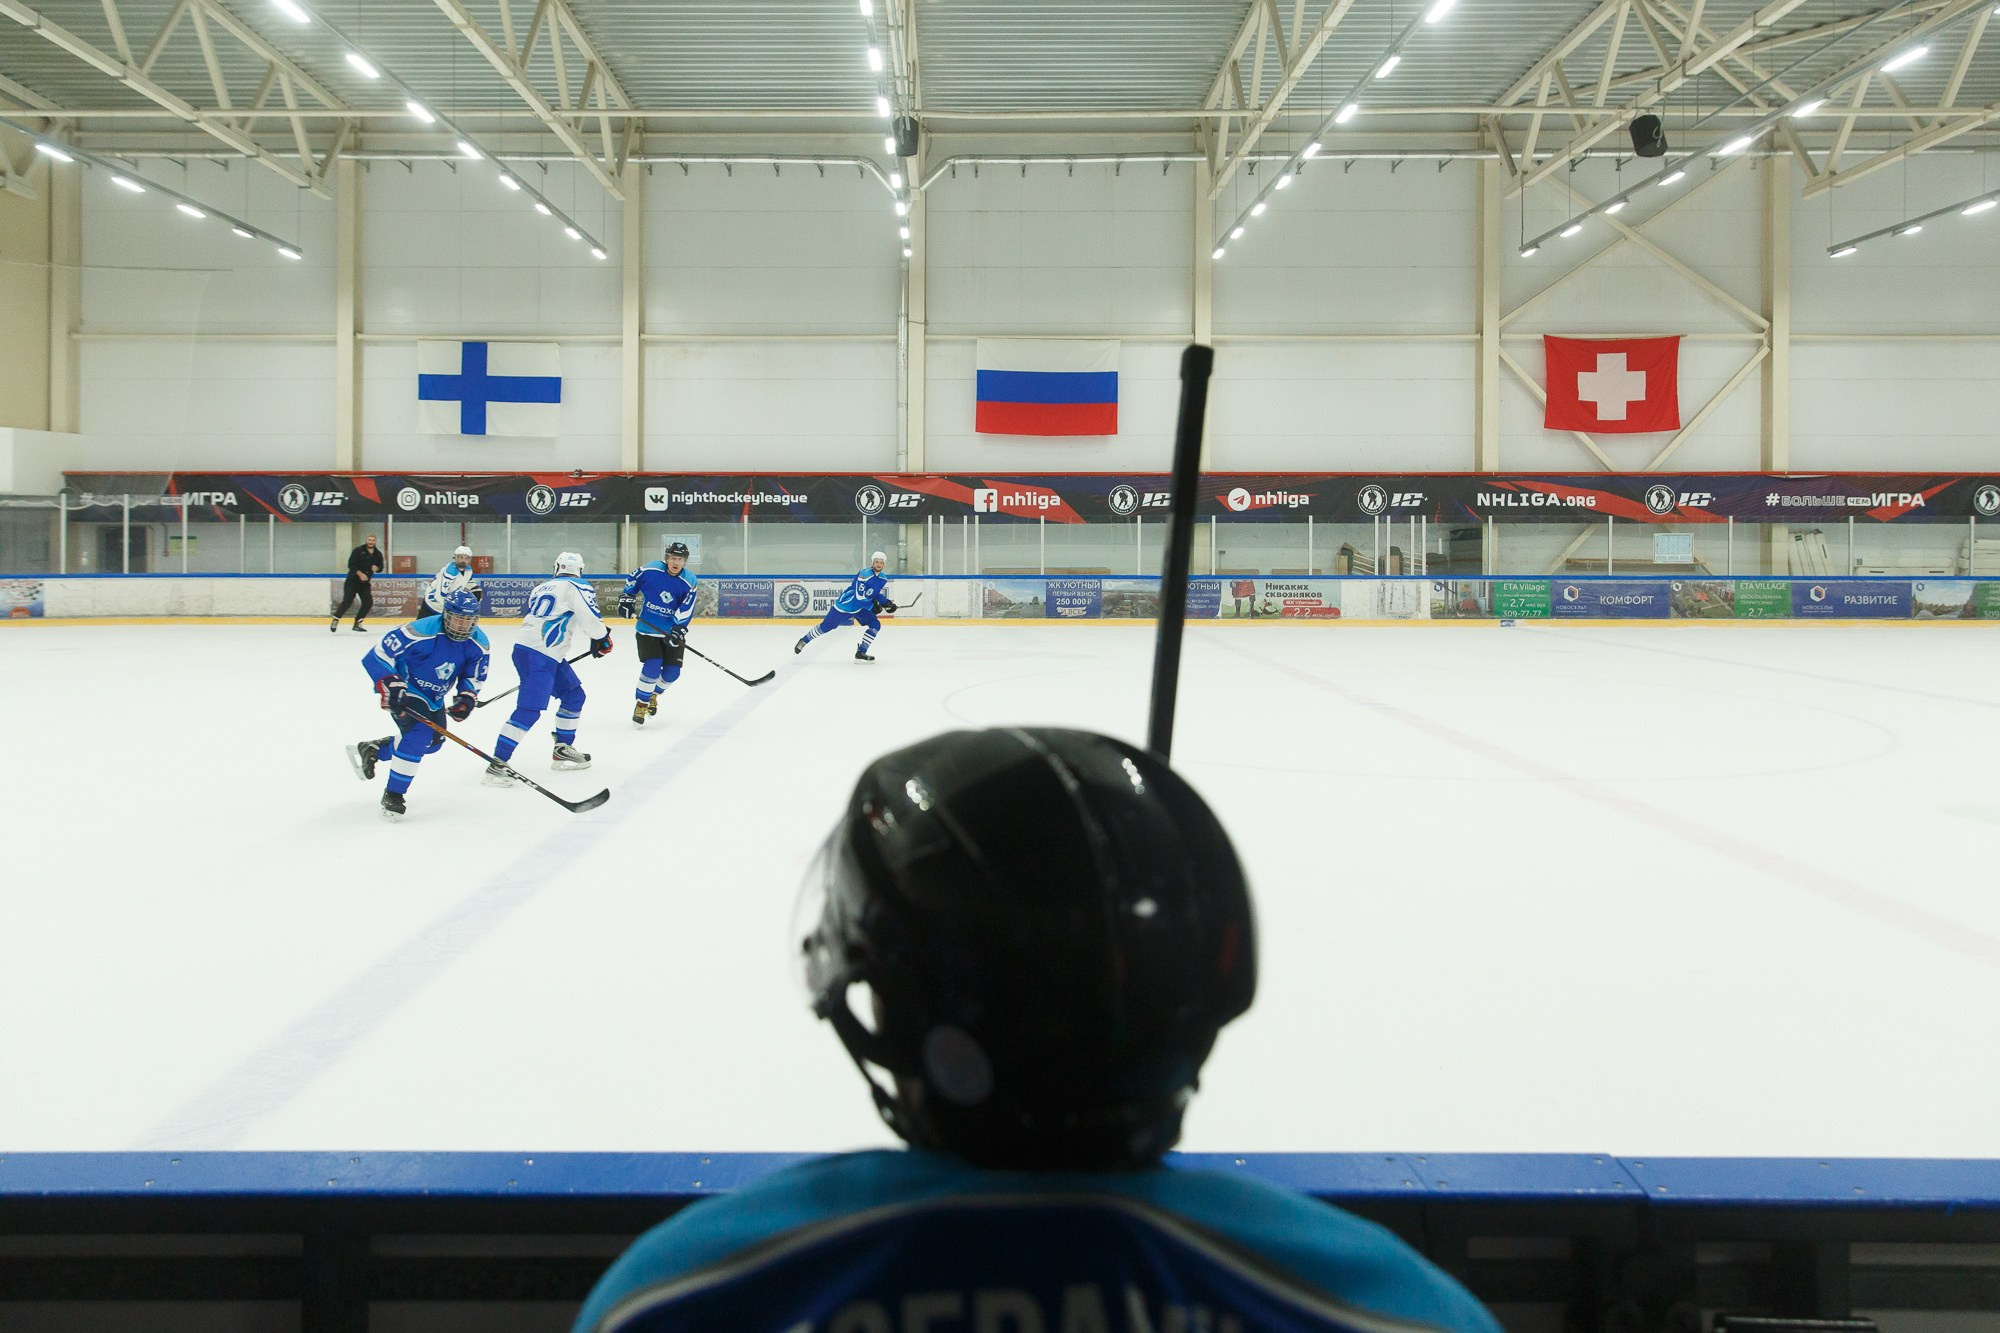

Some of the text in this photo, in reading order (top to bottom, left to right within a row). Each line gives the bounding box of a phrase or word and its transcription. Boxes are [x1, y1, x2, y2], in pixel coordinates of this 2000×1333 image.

[424, 491, 480, 508] nhliga
[672, 491, 808, 505] nighthockeyleague
[1002, 491, 1061, 509] nhliga
[1255, 491, 1310, 508] nhliga
[1476, 492, 1596, 507] NHLIGA.ORG
[735, 581, 773, 590] УЮТНЫЙ
[1048, 580, 1101, 589] ЖК УЮТНЫЙ
[1187, 581, 1220, 590] ЮТНЫЙ
[1265, 582, 1309, 591] Никаких
[1503, 582, 1546, 592] ETA Village
[1739, 582, 1787, 590] ETA VILLAGE
[490, 597, 505, 605] 250
[1510, 598, 1525, 608] 2,7
[1600, 595, 1655, 605] КОМФОРТ
[1844, 595, 1898, 605] РАЗВИТИЕ
[1502, 610, 1542, 618] 309-77-77
